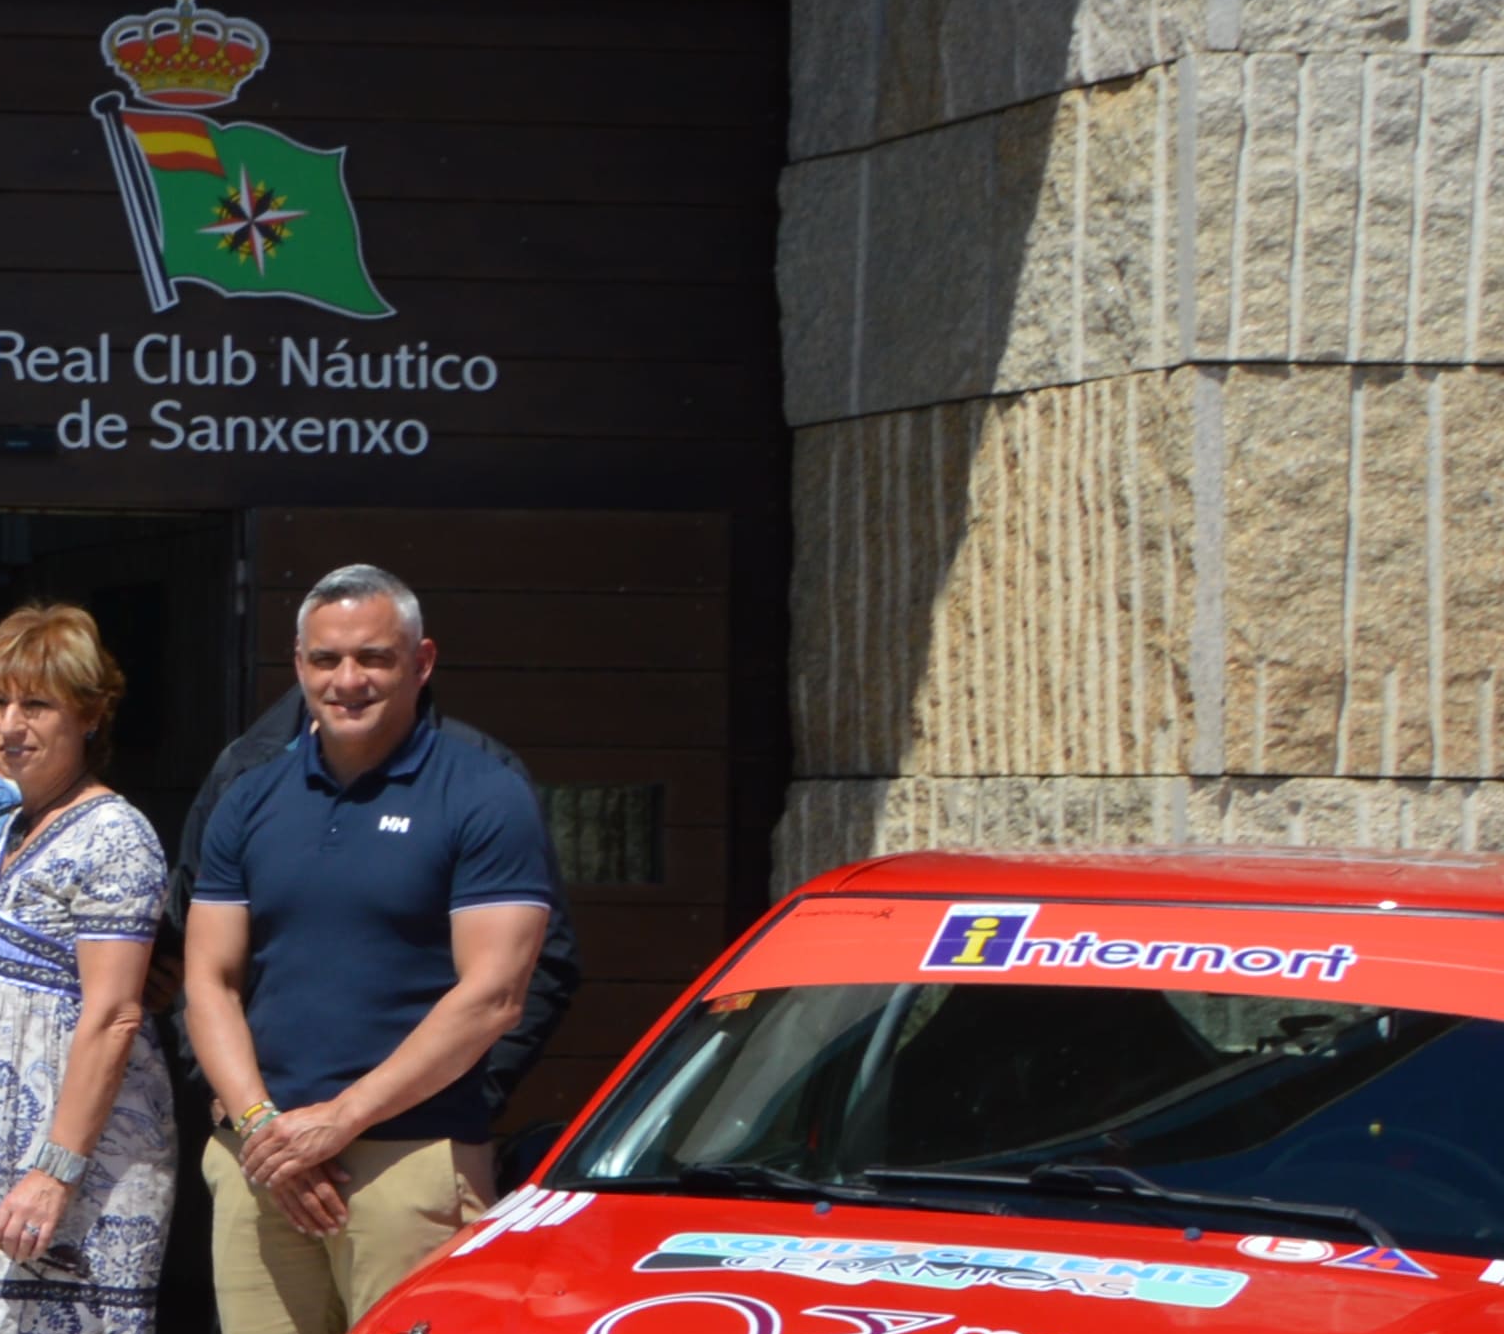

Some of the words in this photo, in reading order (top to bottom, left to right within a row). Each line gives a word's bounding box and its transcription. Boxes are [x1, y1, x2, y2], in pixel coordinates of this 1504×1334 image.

[134, 334, 256, 387] Club
[282, 340, 497, 391] Náutico
[59, 400, 127, 449] de
[150, 402, 428, 454] Sanxenxo
[948, 917, 1354, 982] internort
